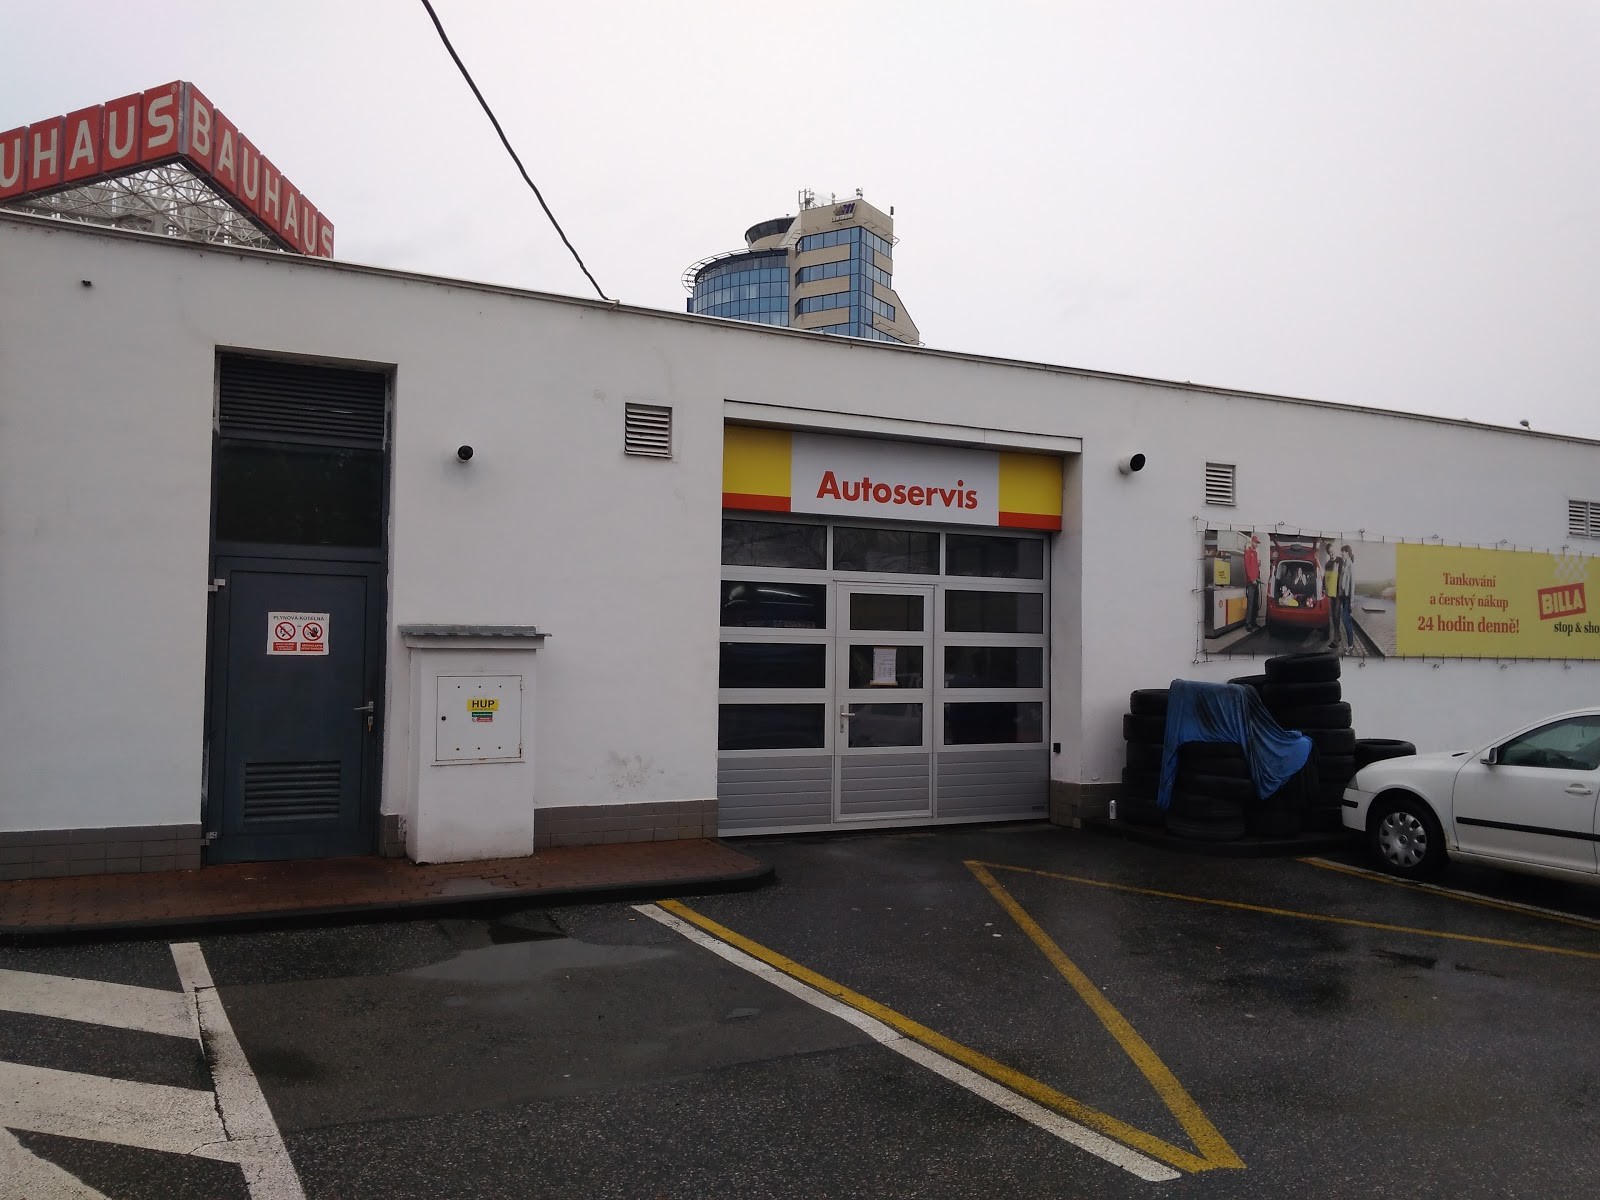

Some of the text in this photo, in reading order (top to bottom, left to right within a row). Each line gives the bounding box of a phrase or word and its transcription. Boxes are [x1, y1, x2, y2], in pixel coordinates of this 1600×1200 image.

[0, 93, 174, 188] UHAUS
[192, 98, 333, 259] BAUHAUS
[816, 470, 978, 510] Autoservis
[1442, 572, 1496, 588] Tankování
[1429, 593, 1509, 612] a čerstvý nákup
[1541, 588, 1584, 615] BILLA
[1417, 615, 1520, 634] 24 hodin denně!
[1553, 621, 1600, 637] stop & sho
[472, 699, 495, 708] HUP
